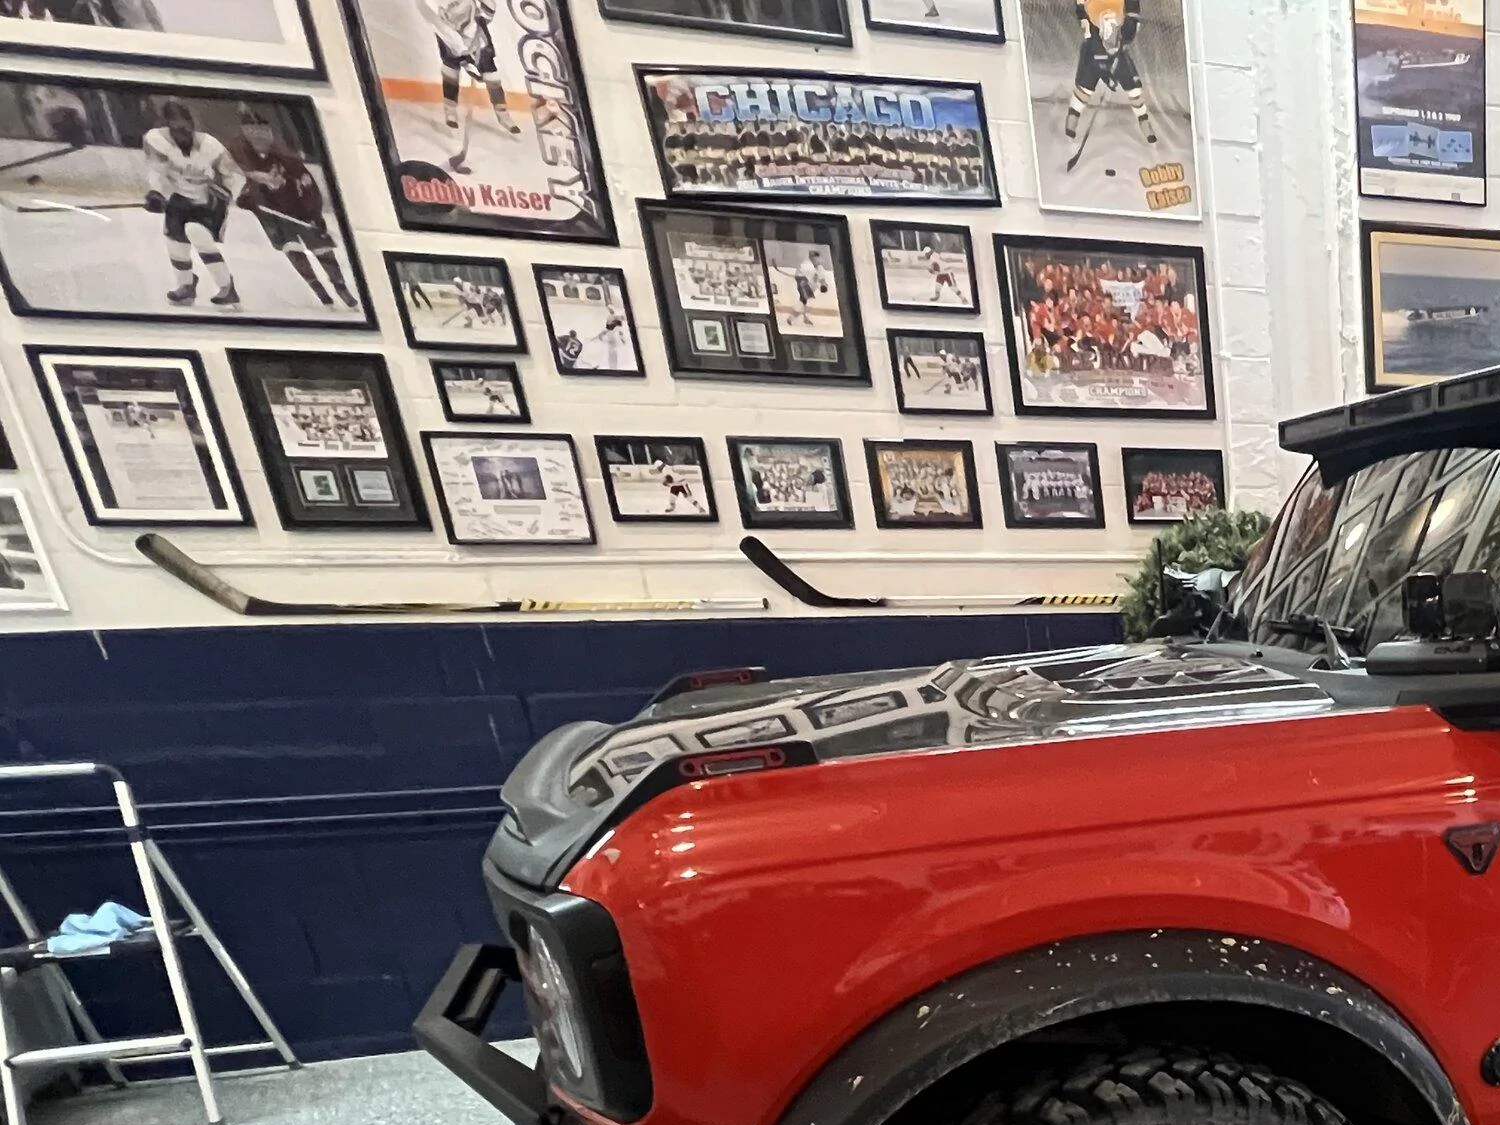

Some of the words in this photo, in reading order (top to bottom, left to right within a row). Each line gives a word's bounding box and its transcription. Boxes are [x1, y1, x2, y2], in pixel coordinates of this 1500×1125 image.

[694, 83, 937, 131] CHICAGO
[402, 176, 476, 207] Bobby
[480, 183, 552, 212] Kaiser
